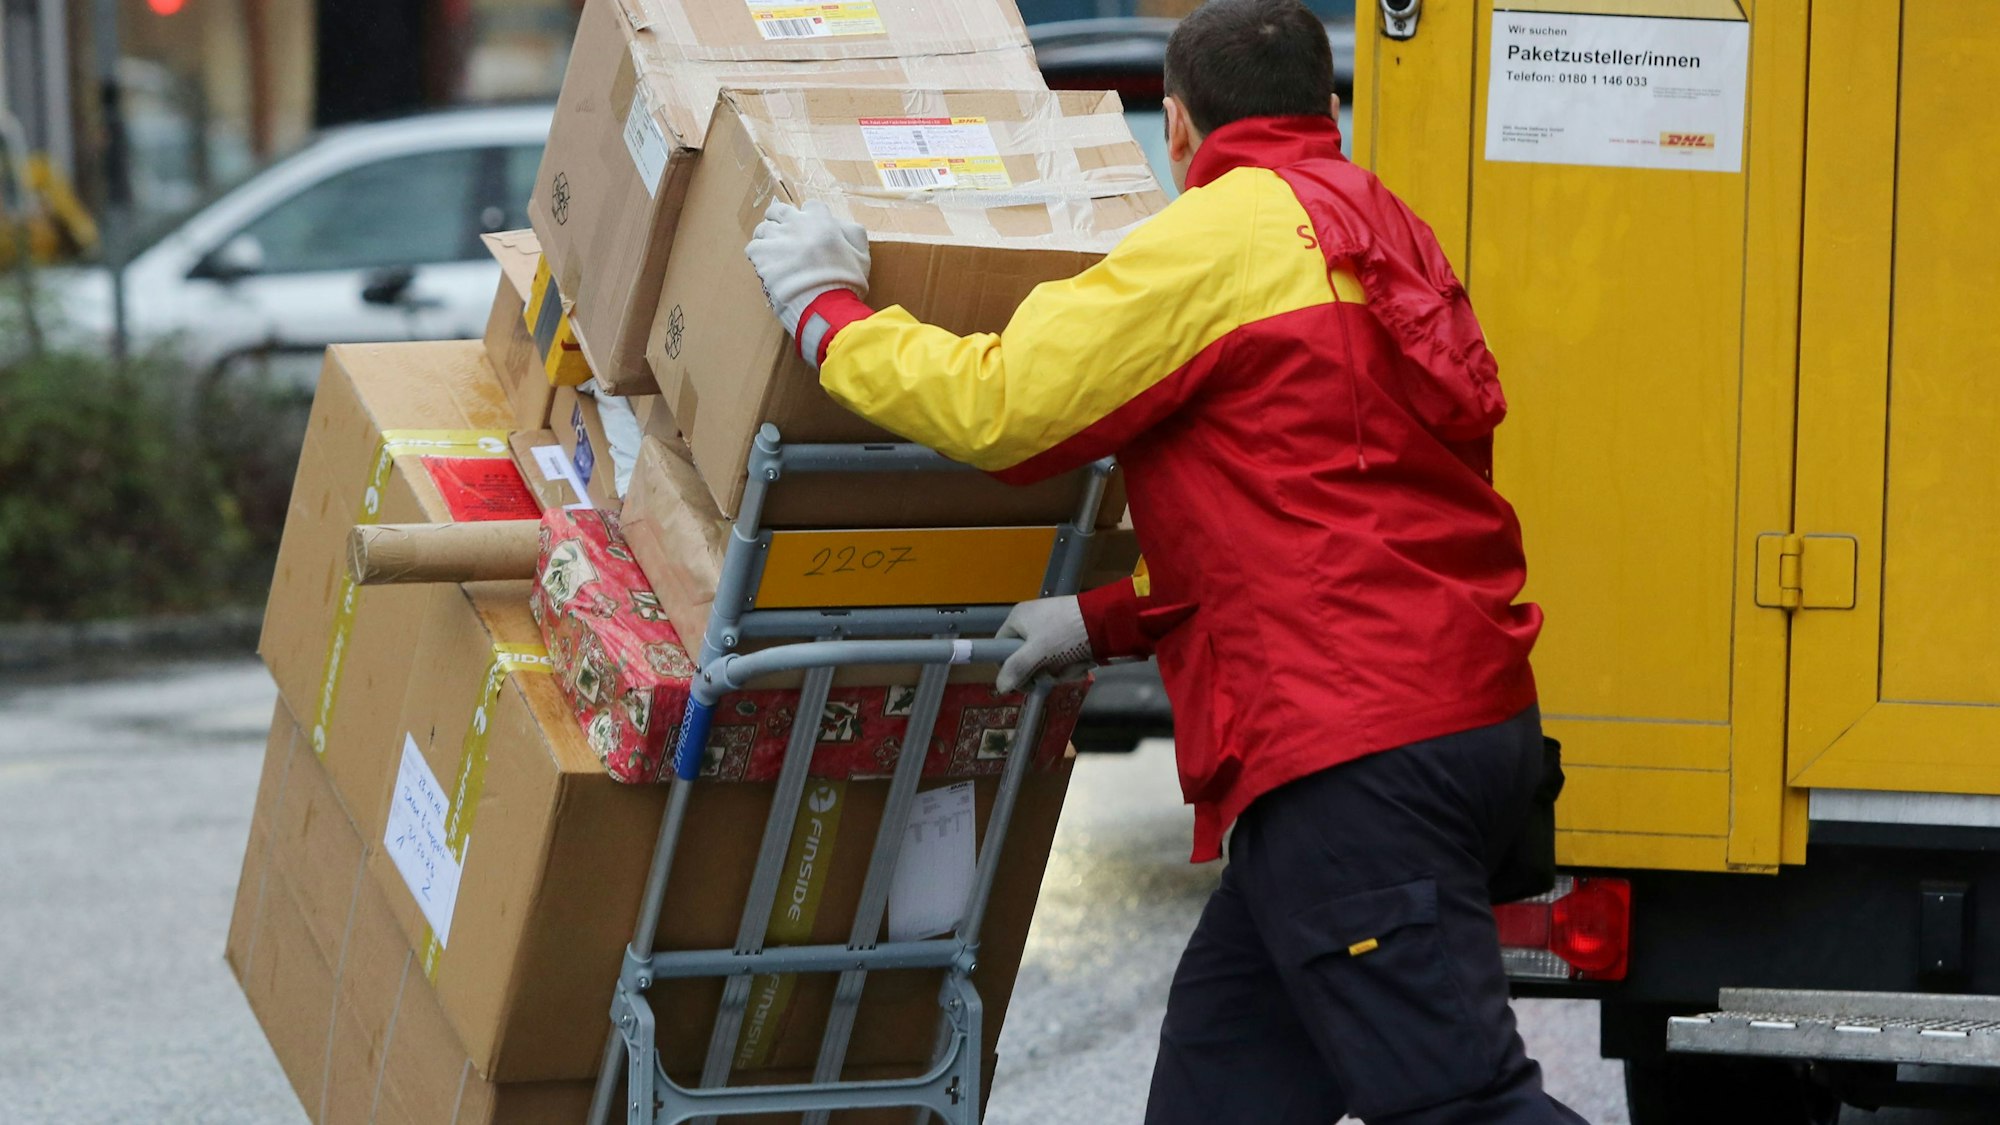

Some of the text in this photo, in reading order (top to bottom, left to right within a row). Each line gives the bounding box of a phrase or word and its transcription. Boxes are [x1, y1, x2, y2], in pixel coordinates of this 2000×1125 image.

[1508, 24, 1567, 36] Wir suchen
[1507, 44, 1700, 69] Paketzusteller/innen
[1507, 70, 1647, 87] Telefon: 0180 1 146 033
[1667, 133, 1706, 147] DHL
[803, 545, 917, 577] 2207
[672, 697, 696, 774] EXPRESSO
[787, 817, 823, 922] FINSIDE
